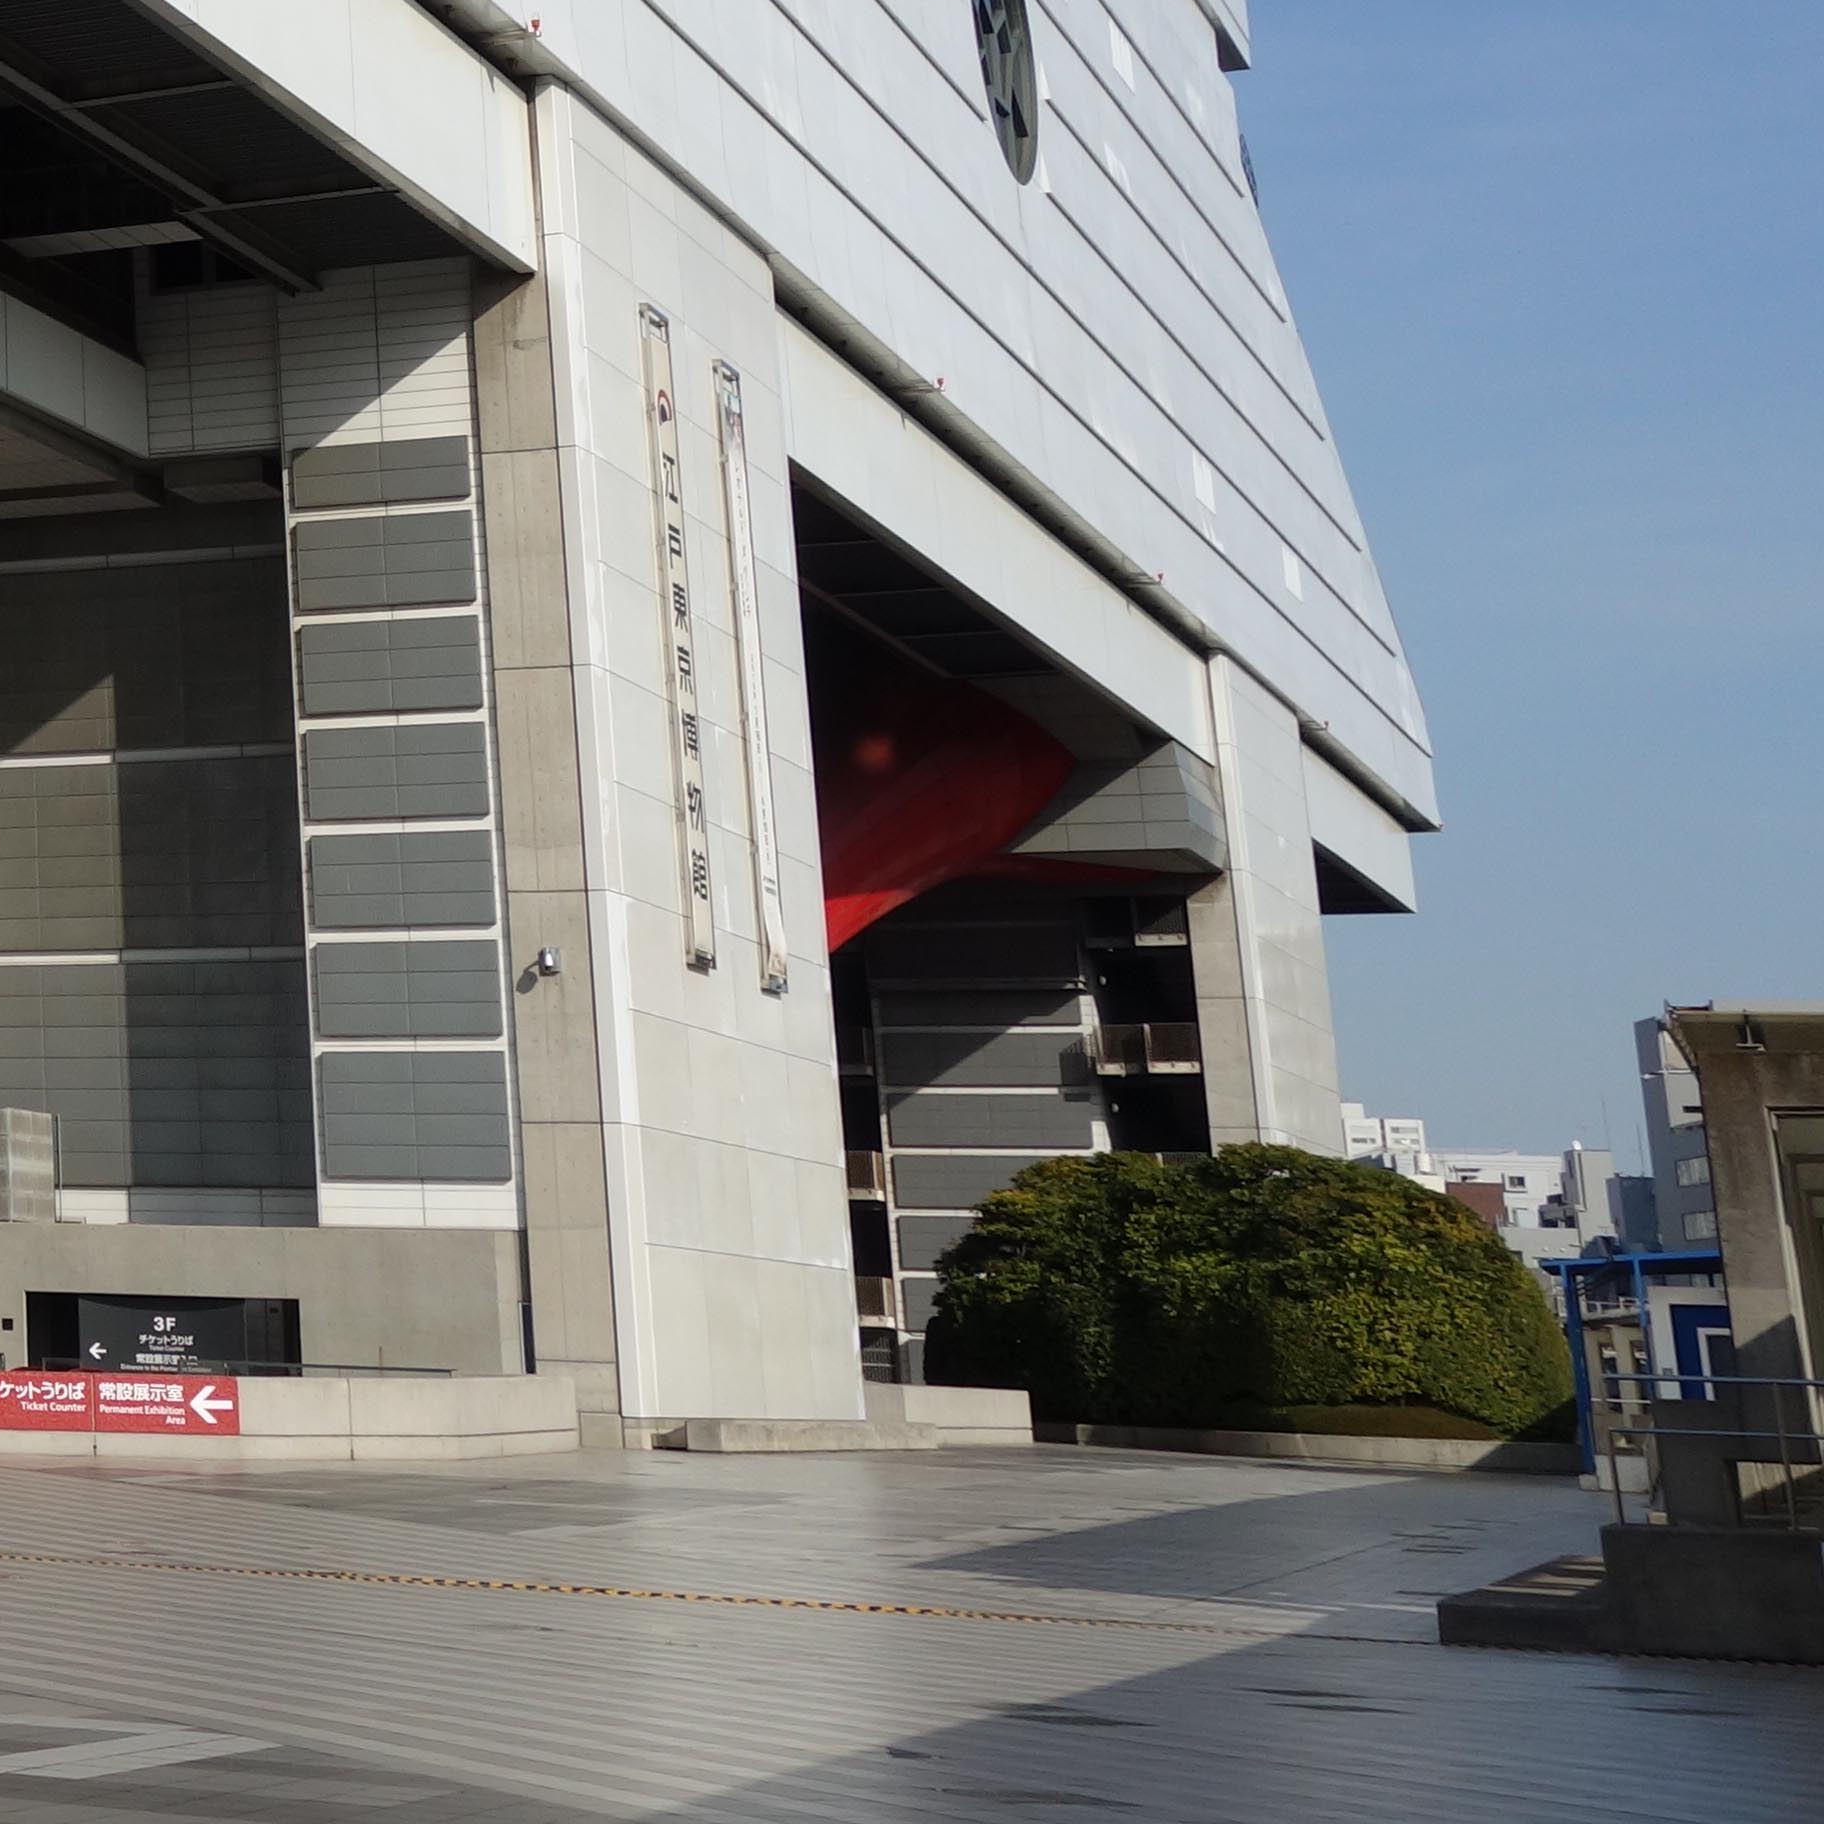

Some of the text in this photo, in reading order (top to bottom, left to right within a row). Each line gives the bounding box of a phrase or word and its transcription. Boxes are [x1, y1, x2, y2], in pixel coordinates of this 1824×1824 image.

[662, 451, 708, 901] 江戸東京博物館
[153, 1316, 177, 1332] 3F
[139, 1334, 194, 1346] チケットうりば
[99, 1382, 185, 1402] 常設展示室
[21, 1401, 89, 1413] Ticket Counter
[99, 1404, 186, 1417] Permanent Exhibition
[165, 1415, 186, 1426] Area
